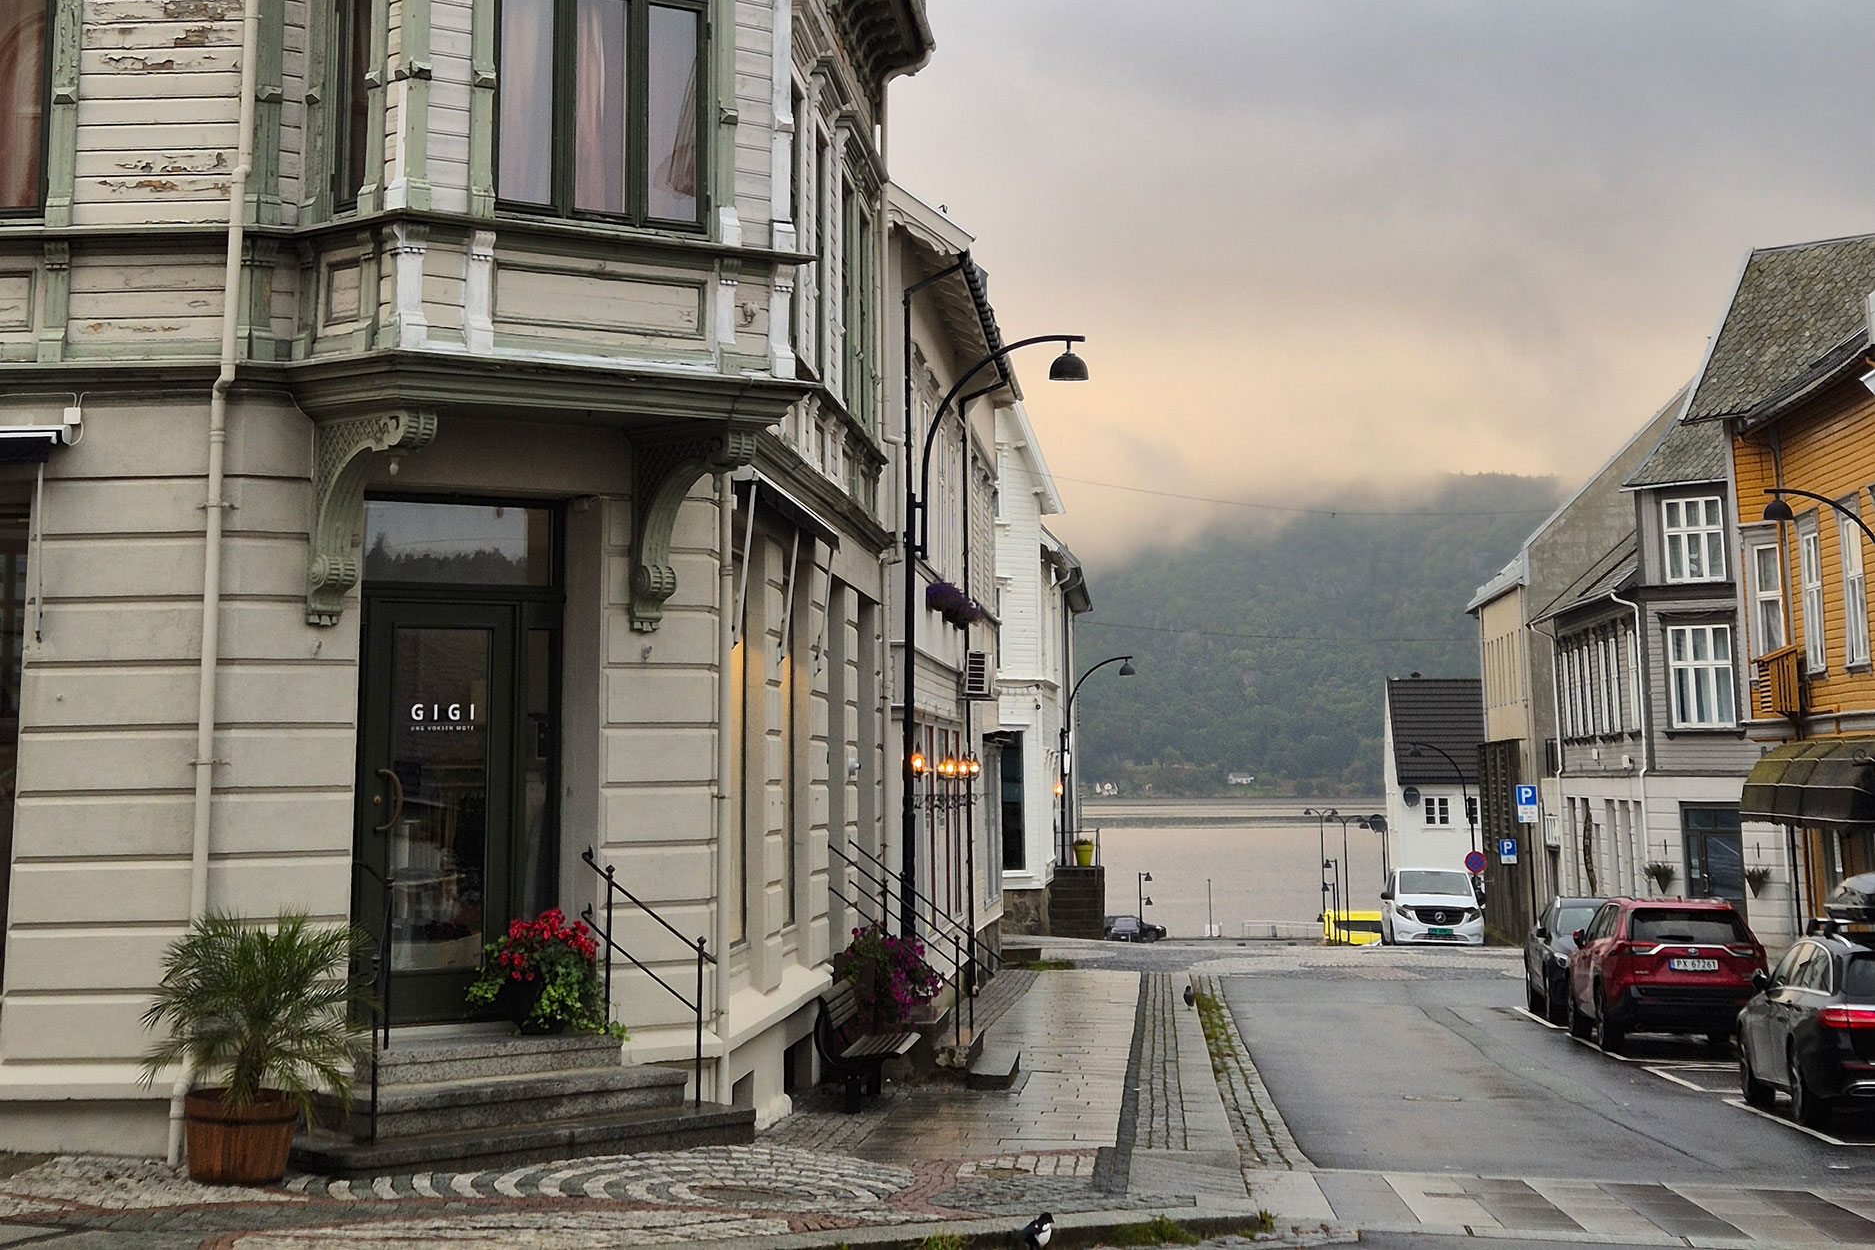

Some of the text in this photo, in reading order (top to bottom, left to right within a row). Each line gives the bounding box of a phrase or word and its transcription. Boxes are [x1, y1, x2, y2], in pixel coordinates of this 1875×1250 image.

[411, 703, 475, 721] GIGI
[1521, 787, 1533, 804] P
[1503, 841, 1513, 854] P
